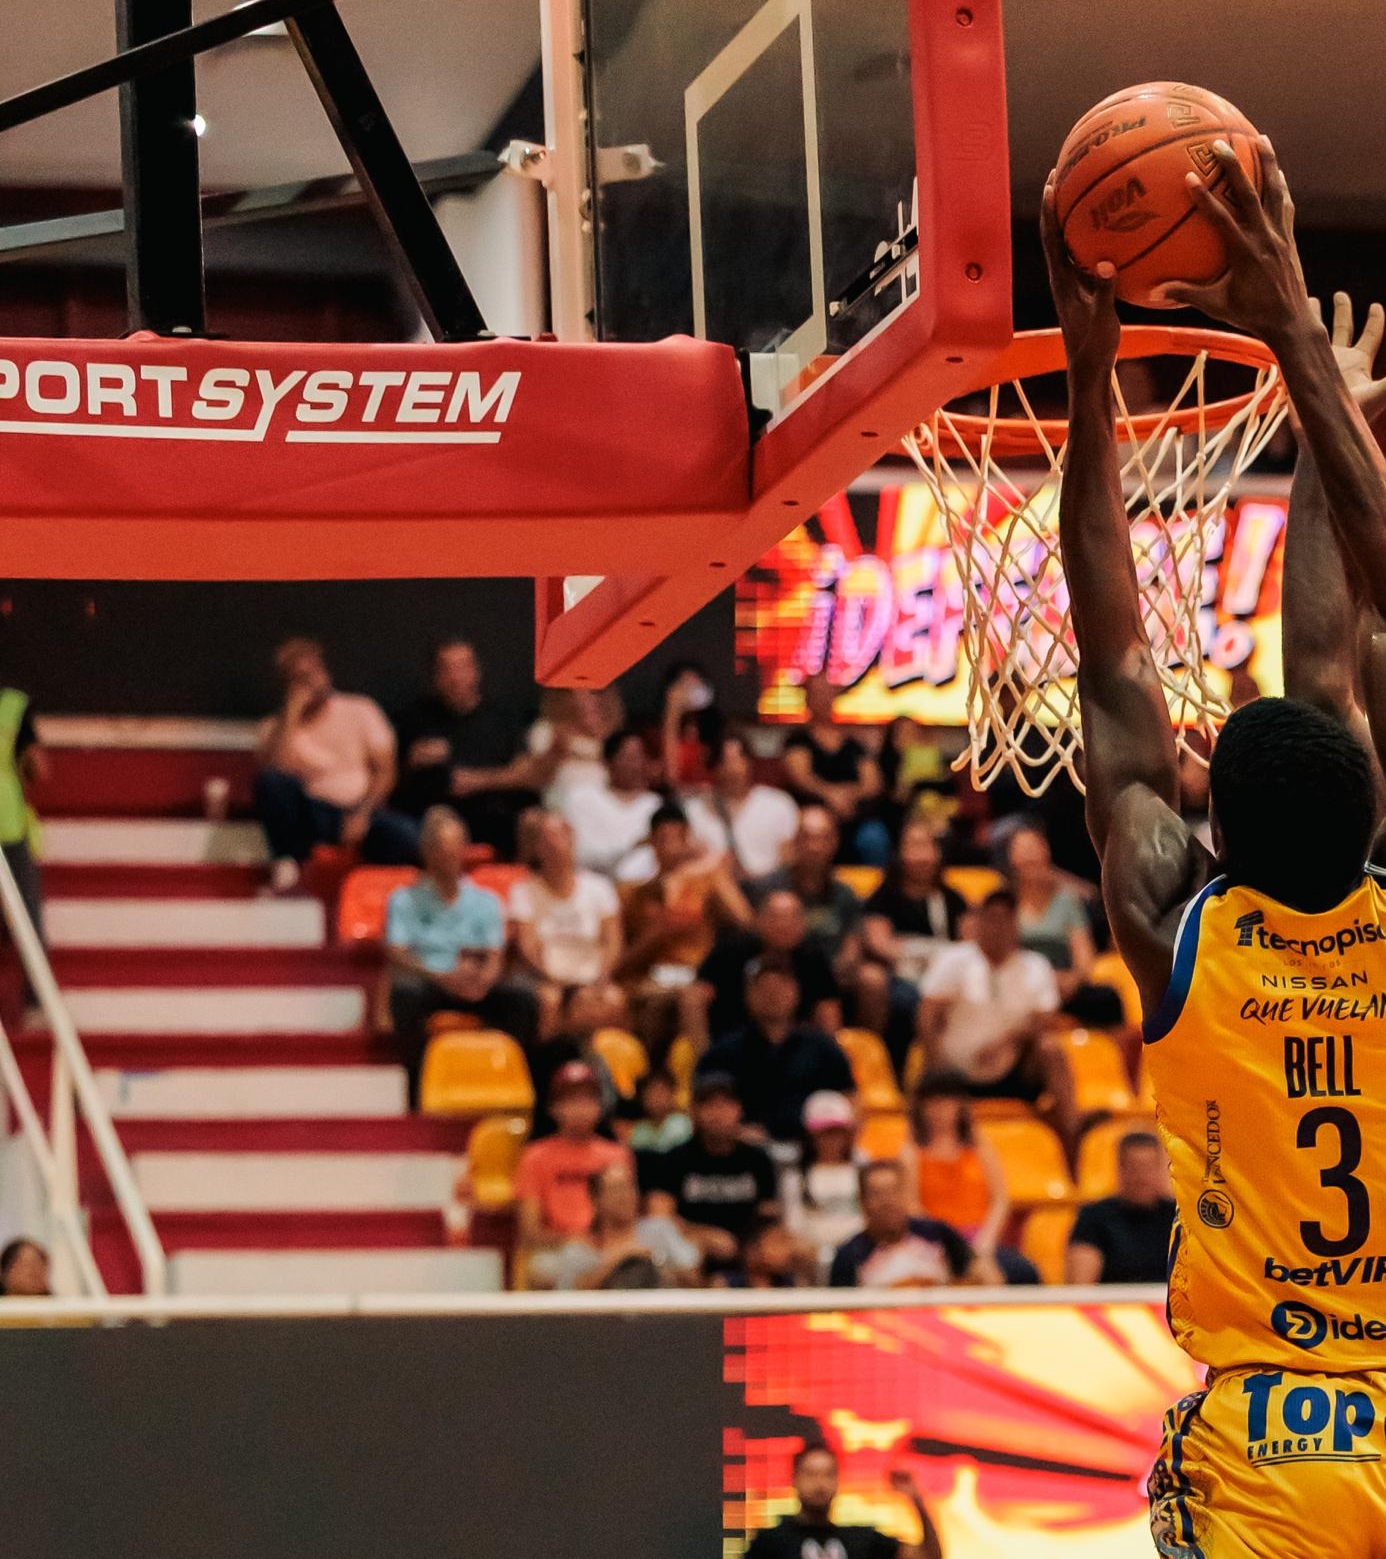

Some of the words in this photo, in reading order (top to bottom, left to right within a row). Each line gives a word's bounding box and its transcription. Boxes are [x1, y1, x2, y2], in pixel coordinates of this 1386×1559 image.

[1261, 970, 1369, 990] NISSAN
[1239, 997, 1295, 1025] QUE
[1283, 1035, 1362, 1098] BELL
[1296, 1106, 1371, 1258] 3
[1242, 1371, 1376, 1452] Top
[1247, 1438, 1323, 1460] ENERGY
